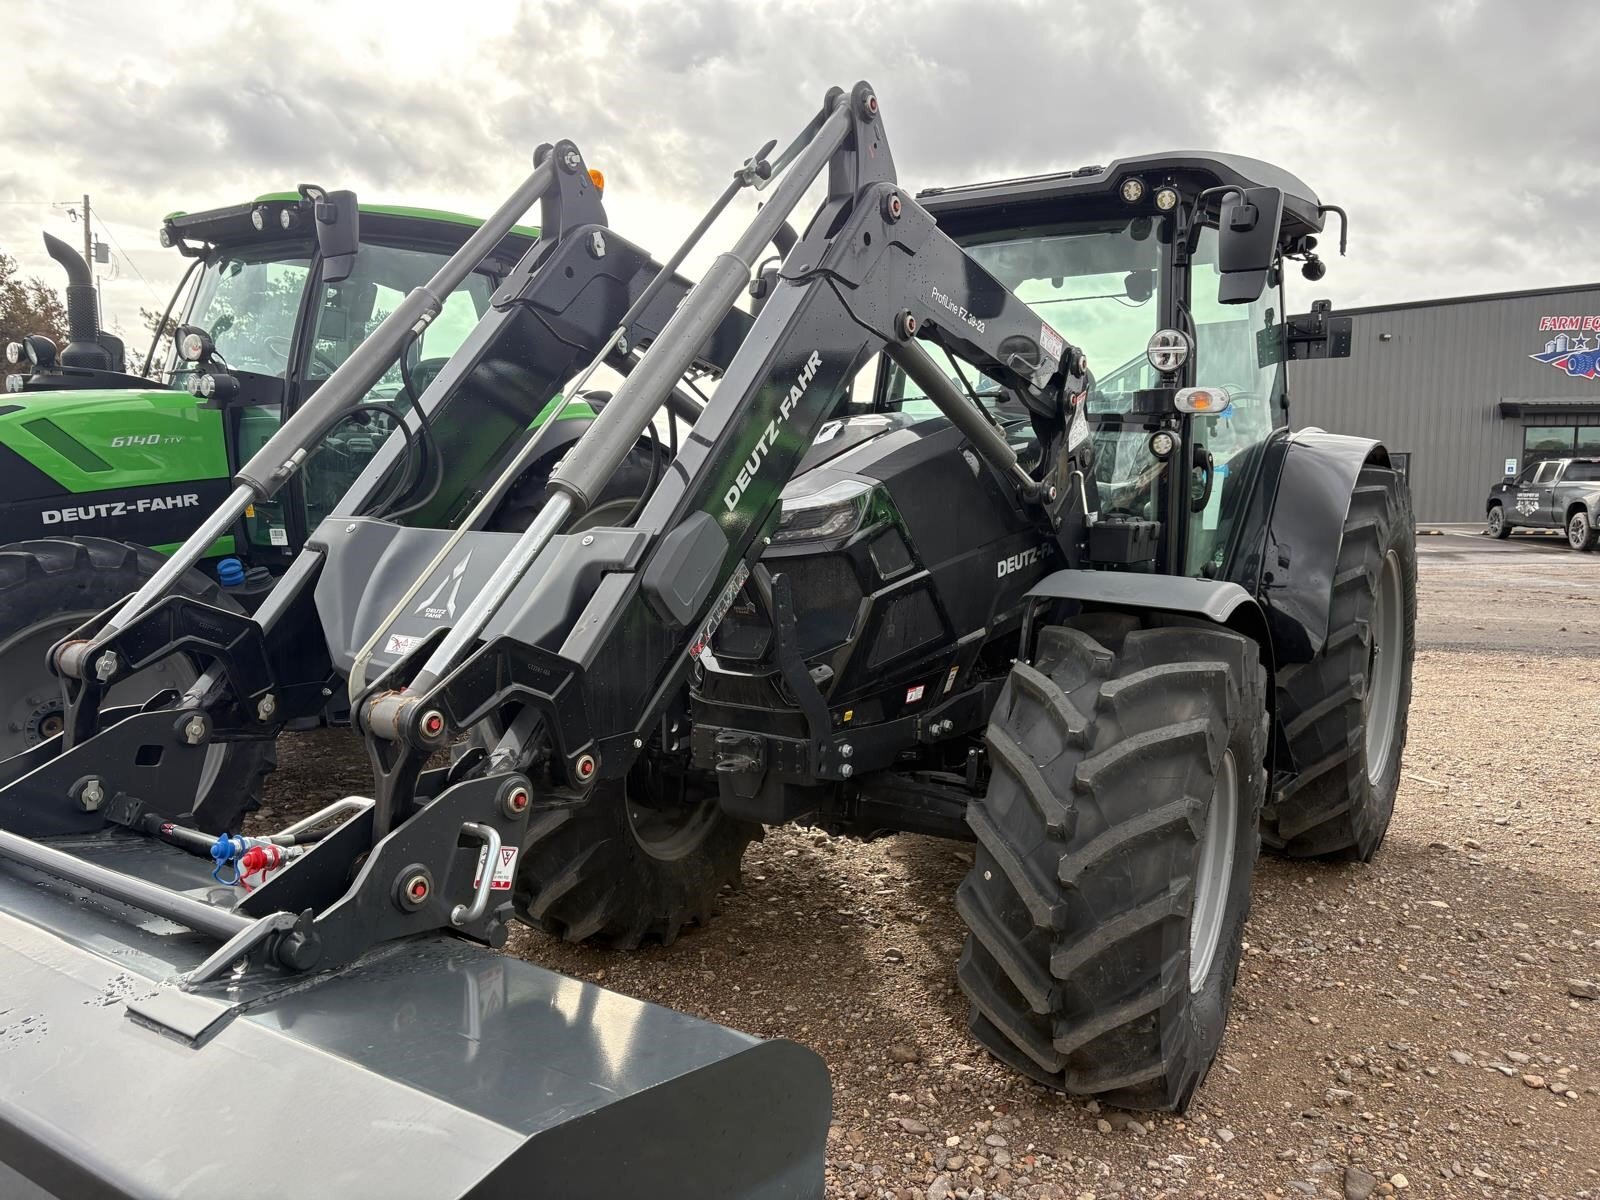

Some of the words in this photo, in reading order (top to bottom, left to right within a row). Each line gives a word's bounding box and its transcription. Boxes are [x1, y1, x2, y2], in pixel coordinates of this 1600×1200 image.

[931, 286, 959, 315] ProfiLine
[958, 306, 968, 322] FZ
[1539, 316, 1582, 331] FARM
[111, 434, 161, 448] 6140
[164, 436, 183, 445] TTV
[723, 350, 823, 512] DEUTZ-FAHR
[41, 493, 200, 525] DEUTZ-FAHR
[425, 607, 447, 615] DEUTZ
